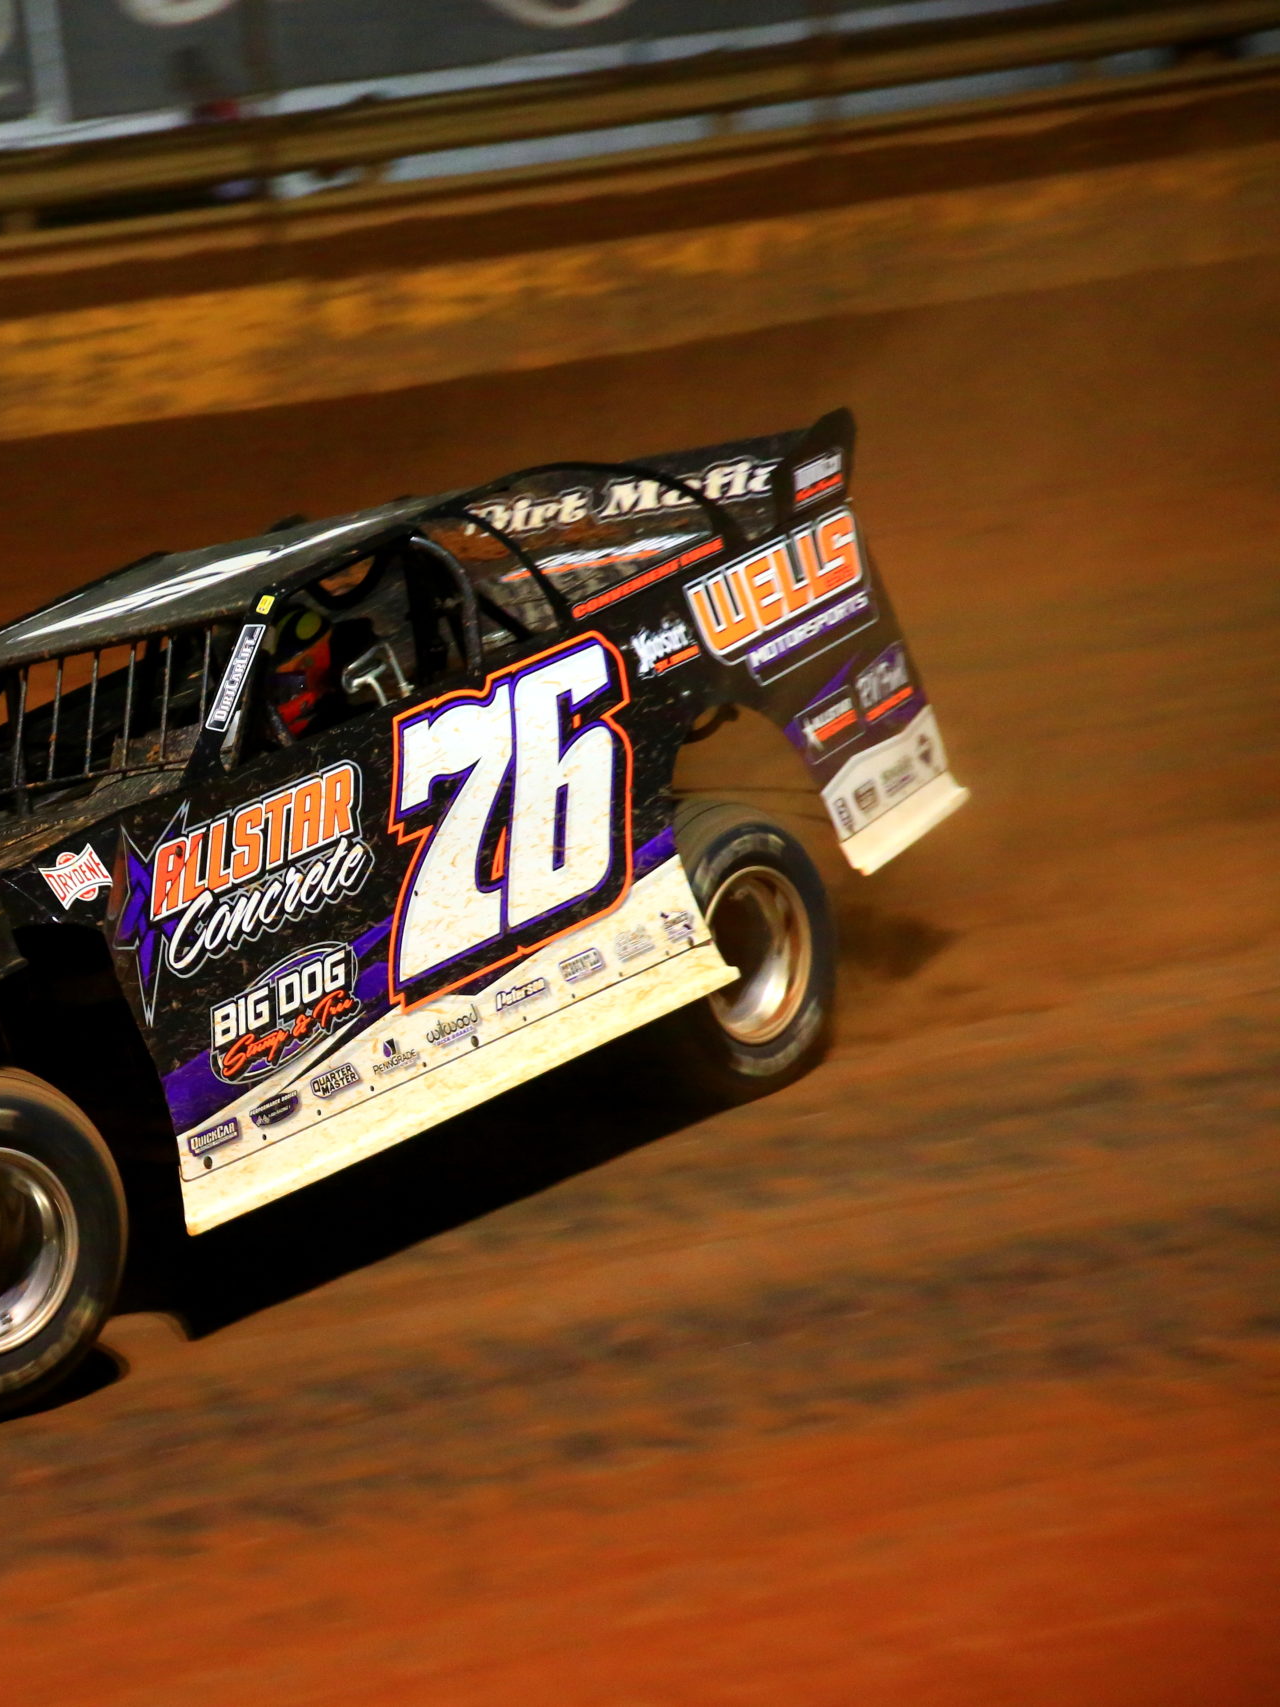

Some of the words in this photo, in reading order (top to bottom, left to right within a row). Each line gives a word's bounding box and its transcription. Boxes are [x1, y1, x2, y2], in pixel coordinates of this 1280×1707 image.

[686, 510, 862, 655] WELLS
[750, 590, 869, 667] MOTORSPORTS
[151, 766, 354, 921] ALLSTAR
[394, 638, 618, 988] 76
[44, 851, 109, 901] DRYDENE
[170, 838, 364, 969] Concrete
[214, 986, 269, 1047] BIG
[278, 950, 345, 1015] DOG
[313, 1064, 353, 1093] QUARTER
[322, 1072, 358, 1096] MASTER
